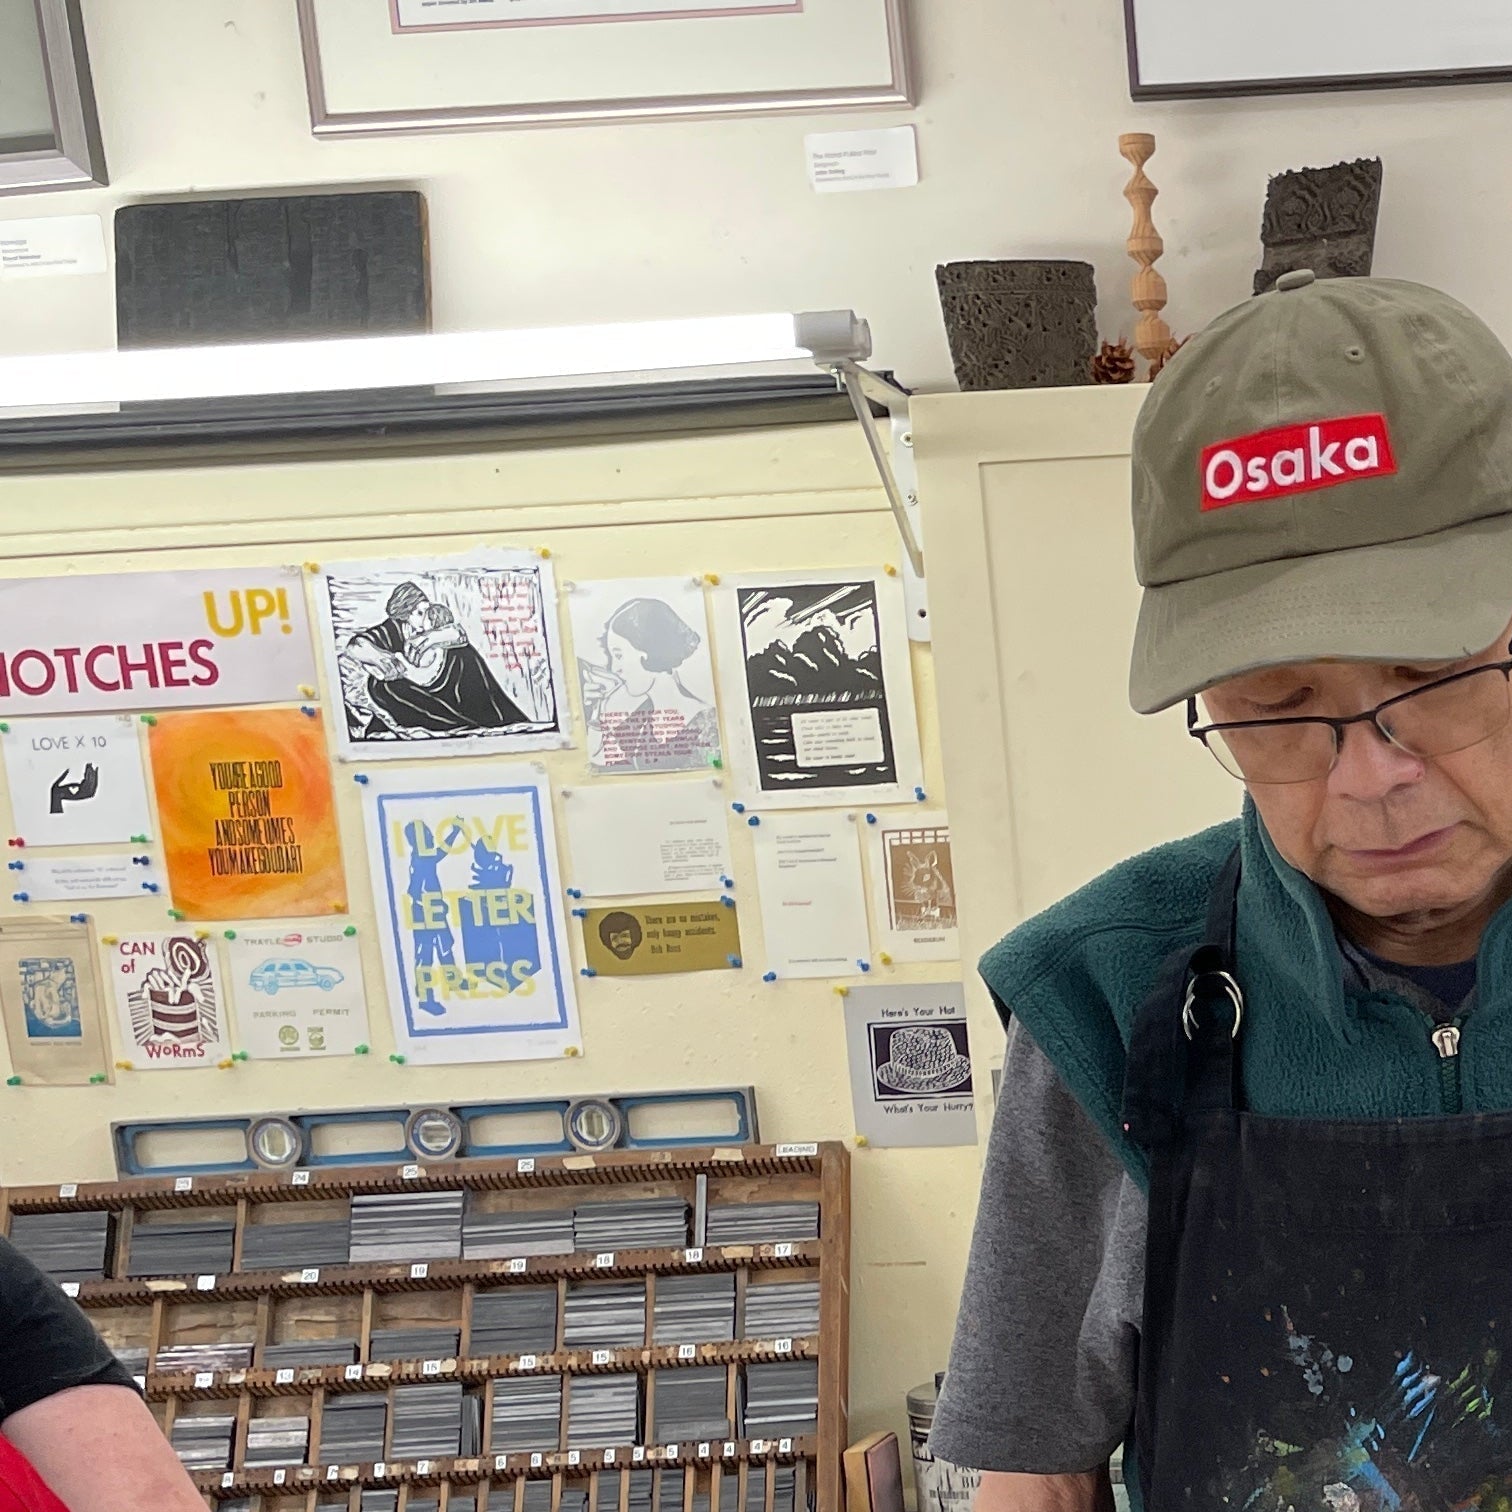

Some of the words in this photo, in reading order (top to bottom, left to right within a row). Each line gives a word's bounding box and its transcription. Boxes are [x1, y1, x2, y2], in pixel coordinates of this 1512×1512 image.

[1206, 426, 1379, 499] Osaka
[203, 588, 292, 638] UP!
[0, 638, 219, 697] OTCHES
[32, 737, 69, 750] LOVE
[75, 736, 85, 747] X
[92, 736, 106, 747] 10
[228, 790, 271, 818] PERSON
[392, 821, 405, 857] I
[413, 814, 529, 857] LOVE
[402, 889, 536, 930] LETTER
[645, 916, 662, 924] There
[306, 935, 343, 943] STUDIO
[119, 941, 156, 956] CAN
[121, 959, 135, 974] of
[415, 960, 537, 1002] PRESS
[253, 1010, 297, 1018] PARKING
[313, 1008, 349, 1016] PERMIT
[881, 1008, 909, 1018] Here's
[913, 1007, 934, 1016] Your
[939, 1006, 955, 1015] Hat
[883, 1104, 913, 1113] What's
[917, 1103, 938, 1112] Your
[520, 1160, 533, 1170] 25
[687, 1249, 700, 1260] 18
[776, 1244, 790, 1255] 17
[512, 1260, 525, 1271] 19
[599, 1254, 611, 1265] 18
[522, 1356, 534, 1367] 15
[595, 1351, 608, 1363] 15
[668, 1445, 676, 1458] 5
[700, 1444, 708, 1455] 4
[724, 1444, 733, 1455] 4
[753, 1441, 762, 1452] 4
[781, 1440, 789, 1451] 4
[570, 1451, 577, 1463] 5
[606, 1450, 613, 1462] 5
[634, 1447, 642, 1459] 5
